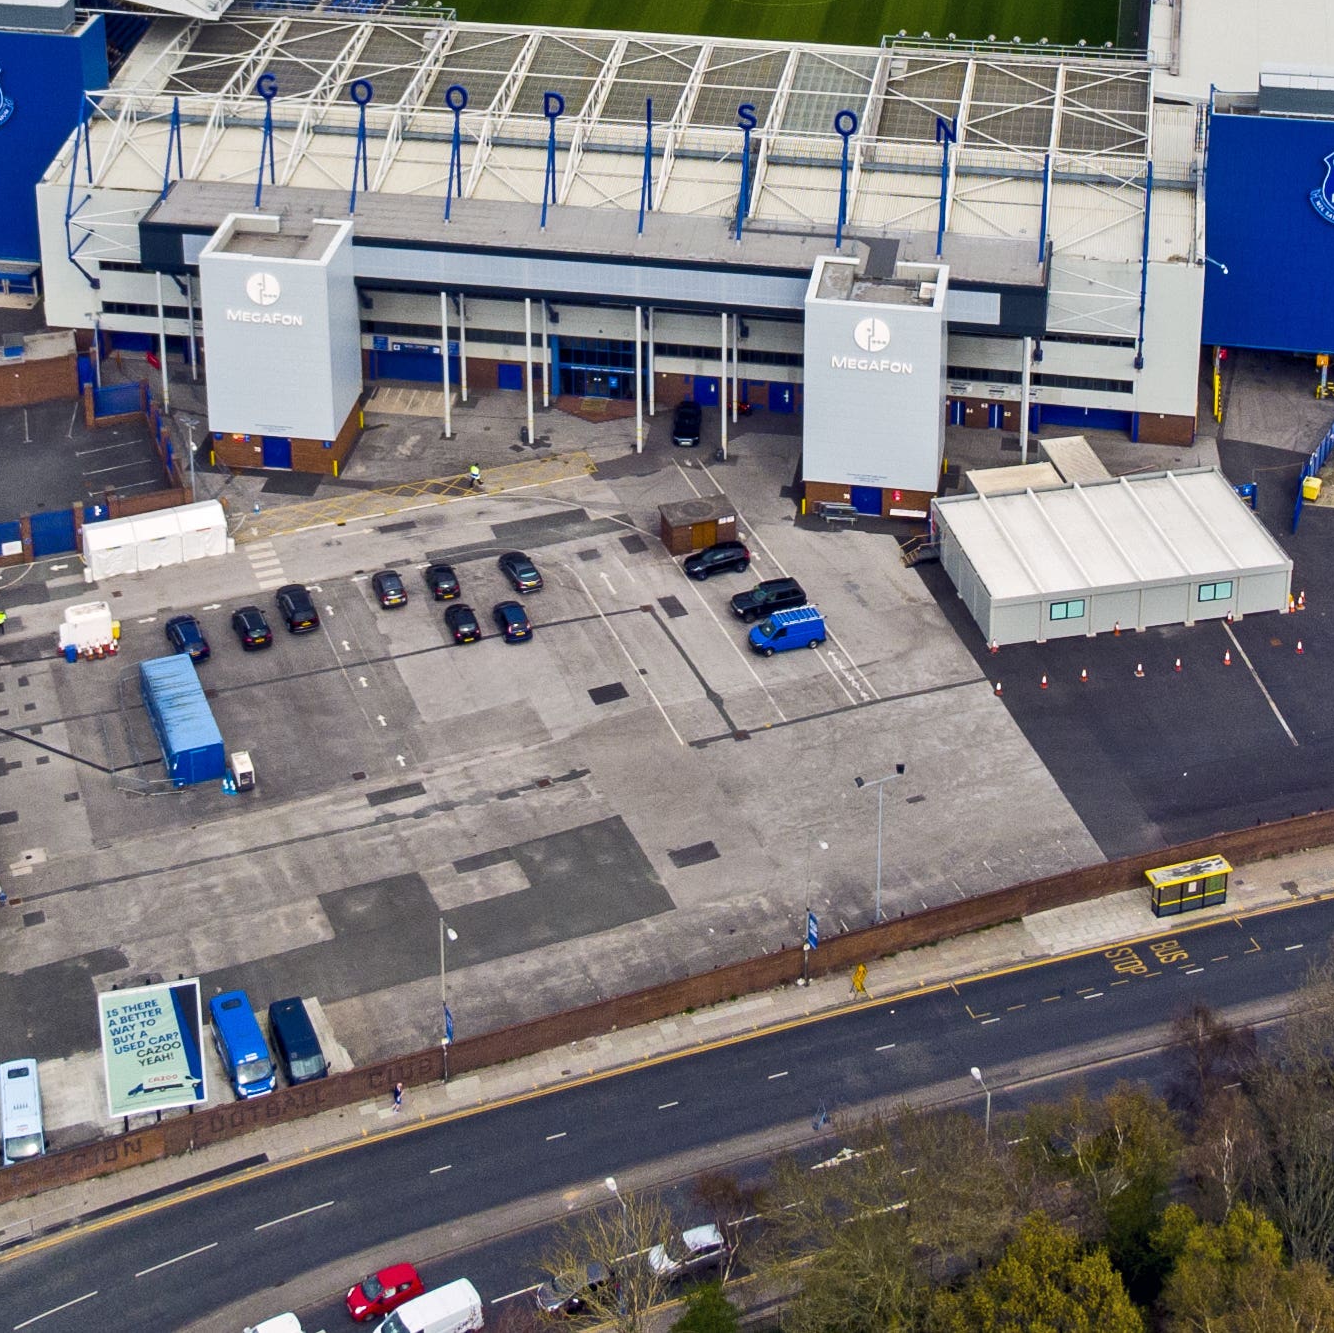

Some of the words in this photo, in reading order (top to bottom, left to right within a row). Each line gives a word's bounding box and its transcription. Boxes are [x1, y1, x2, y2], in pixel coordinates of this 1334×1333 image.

[1104, 947, 1148, 975] STOP
[1149, 939, 1189, 964] BUS
[107, 1008, 119, 1019] IS
[122, 999, 159, 1015] THERE
[108, 1019, 116, 1027] A
[120, 1007, 163, 1025] BETTER
[109, 1024, 136, 1037] WAY
[140, 1018, 156, 1027] TO
[112, 1033, 136, 1046] BUY
[140, 1030, 148, 1039] A
[114, 1040, 146, 1055] USED
[148, 1031, 179, 1046] CAR?
[136, 1041, 182, 1058] CAZOO
[138, 1052, 174, 1067] YEAH!
[148, 1074, 178, 1083] CAZOO
[192, 1087, 326, 1139] FOOTBALL
[367, 1057, 434, 1090] CLUB
